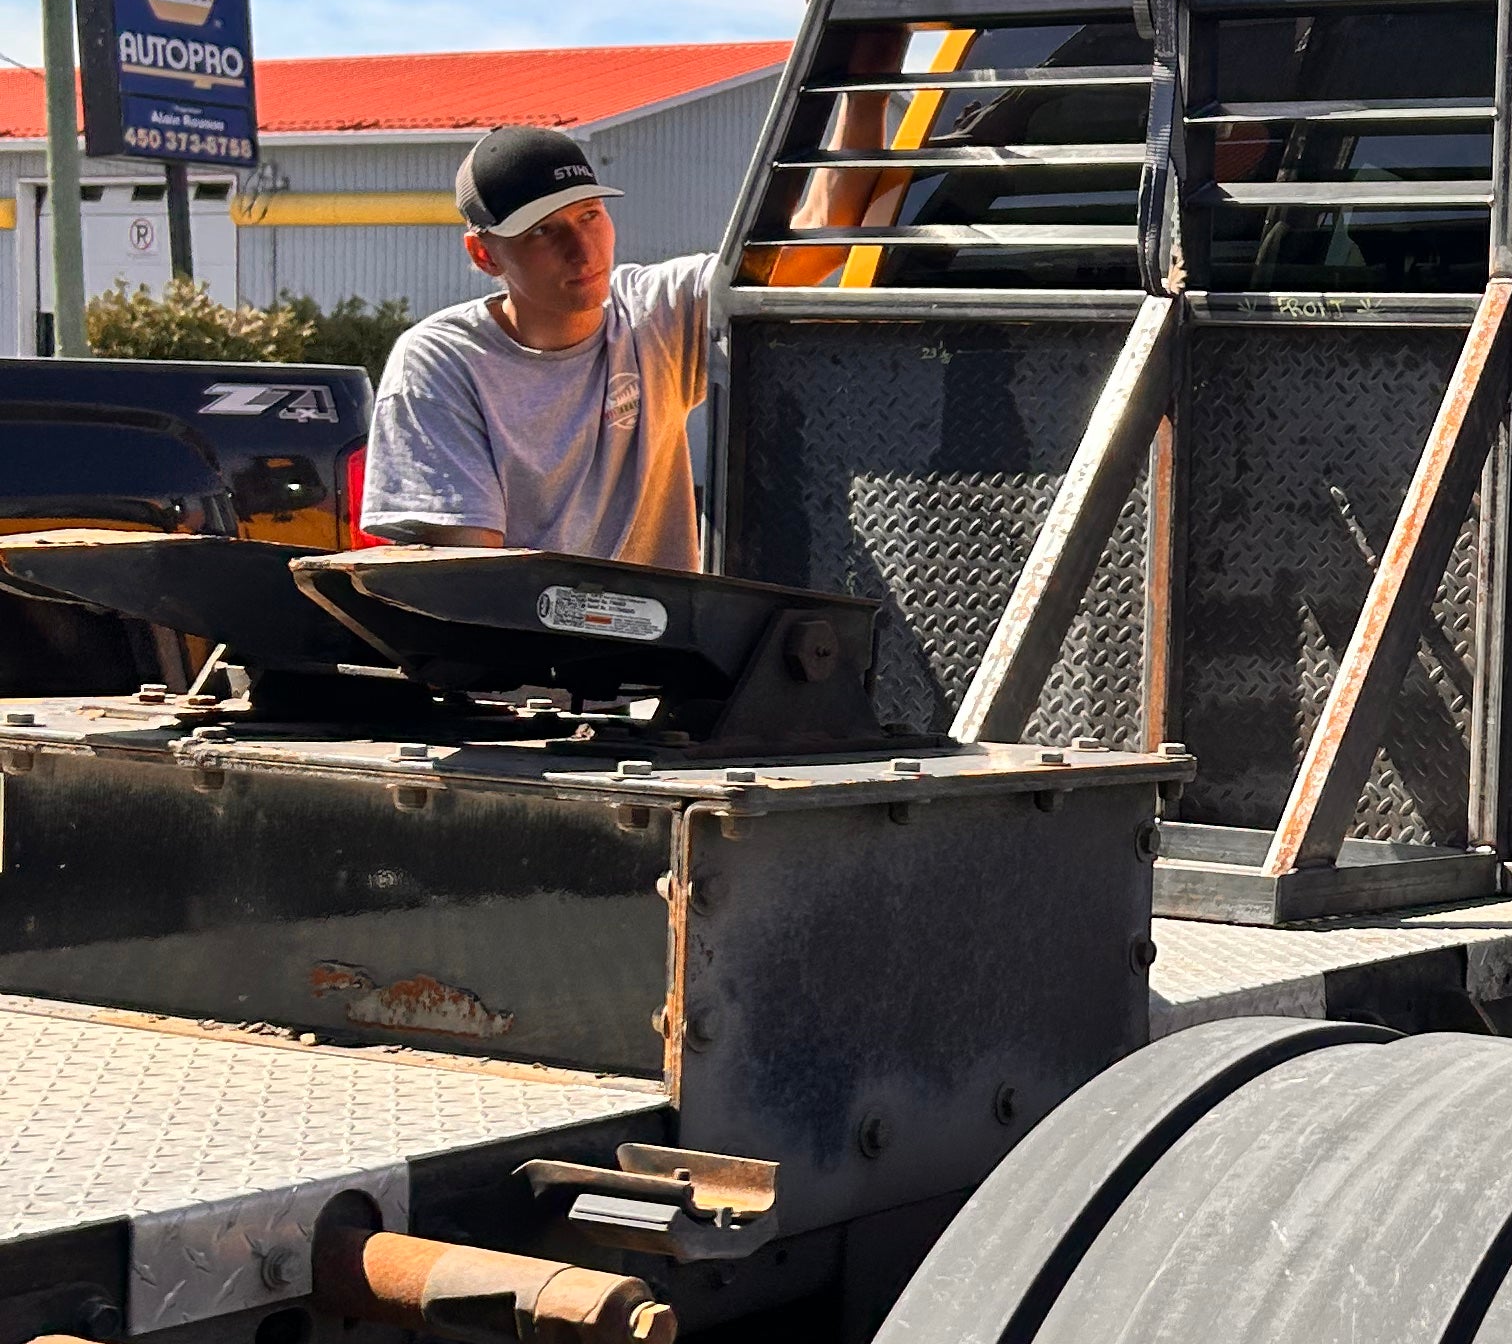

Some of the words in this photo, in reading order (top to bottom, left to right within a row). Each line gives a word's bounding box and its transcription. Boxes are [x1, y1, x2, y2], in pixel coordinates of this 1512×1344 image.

[119, 31, 244, 77] AUTOPRO
[125, 127, 161, 150] 450
[554, 165, 594, 180] STIHL
